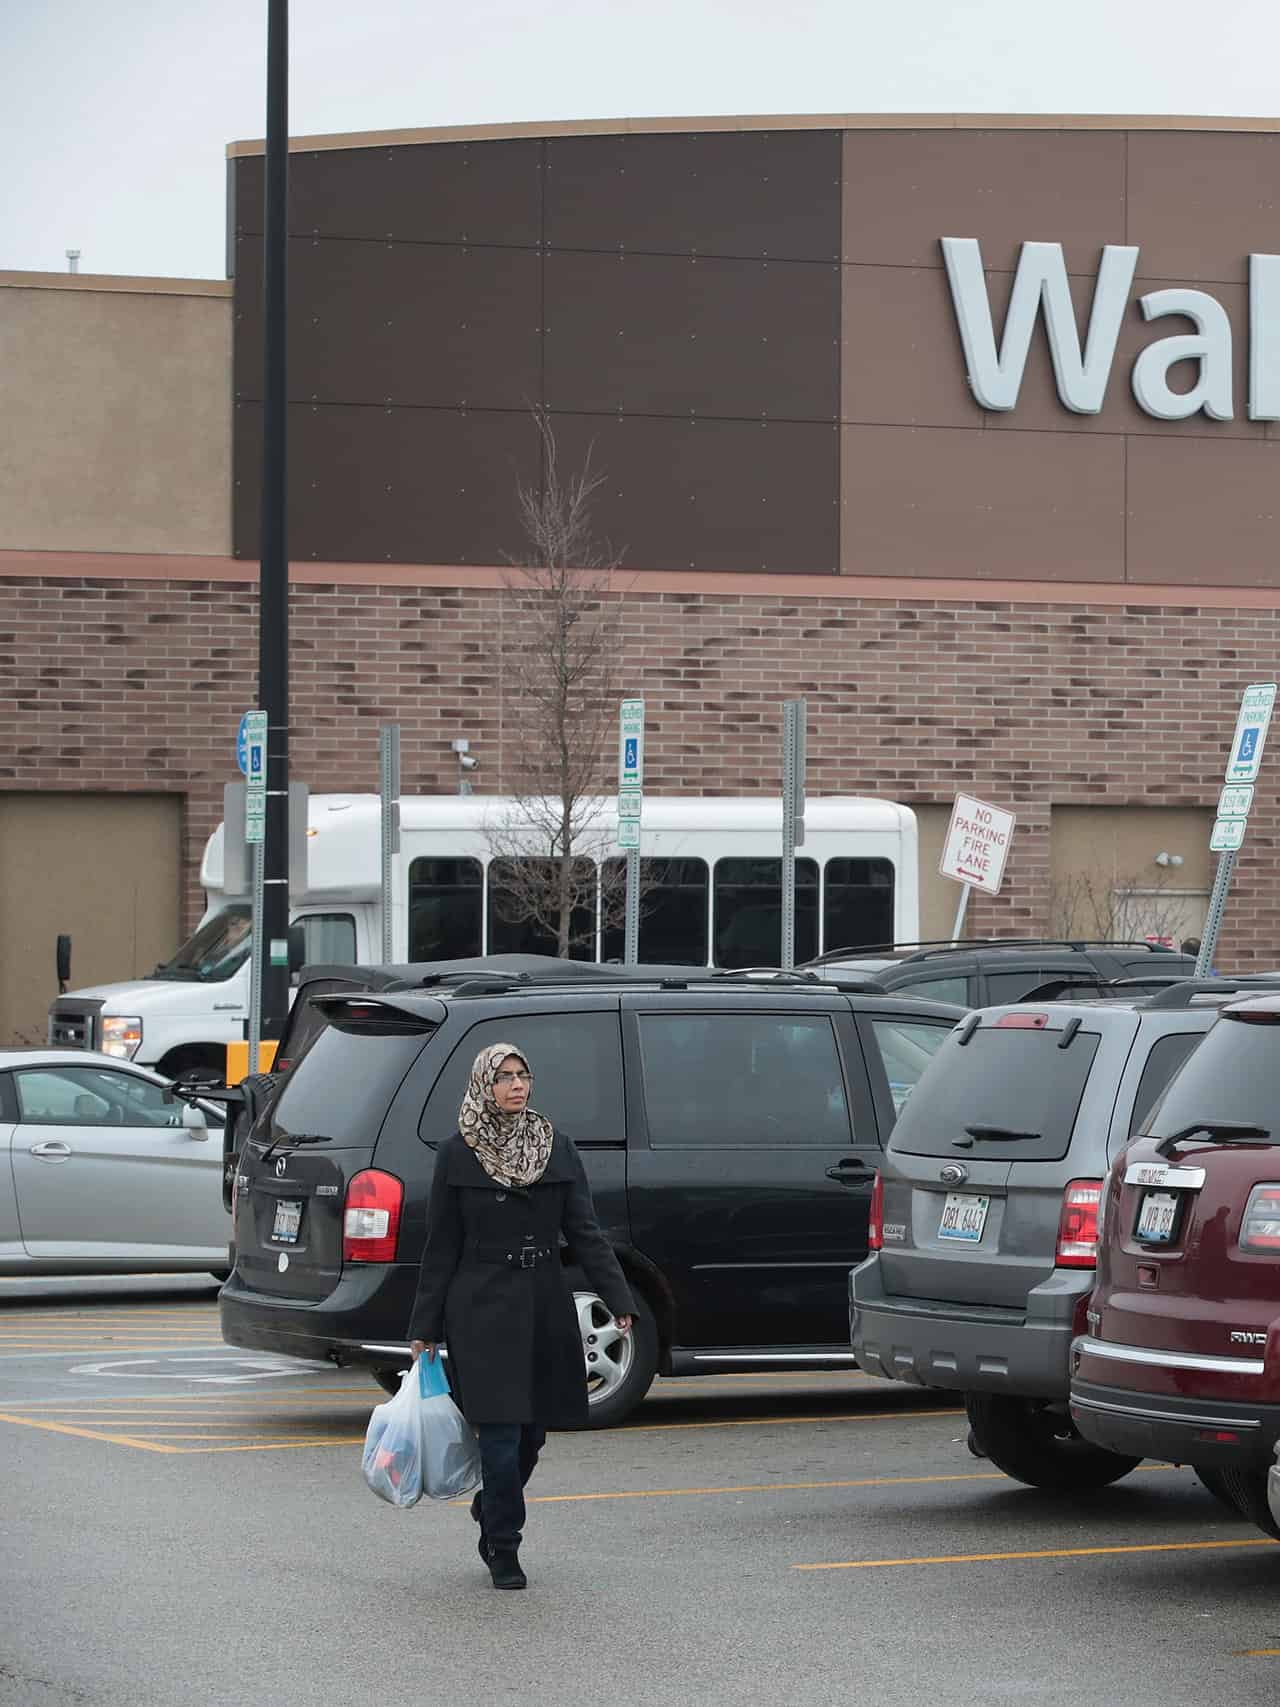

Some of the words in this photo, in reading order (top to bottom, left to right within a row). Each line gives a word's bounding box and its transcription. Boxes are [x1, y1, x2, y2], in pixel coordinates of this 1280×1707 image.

[975, 808, 993, 824] NO
[955, 817, 1006, 846] PARKING
[963, 836, 991, 856] FIRE
[957, 849, 991, 873] LANE
